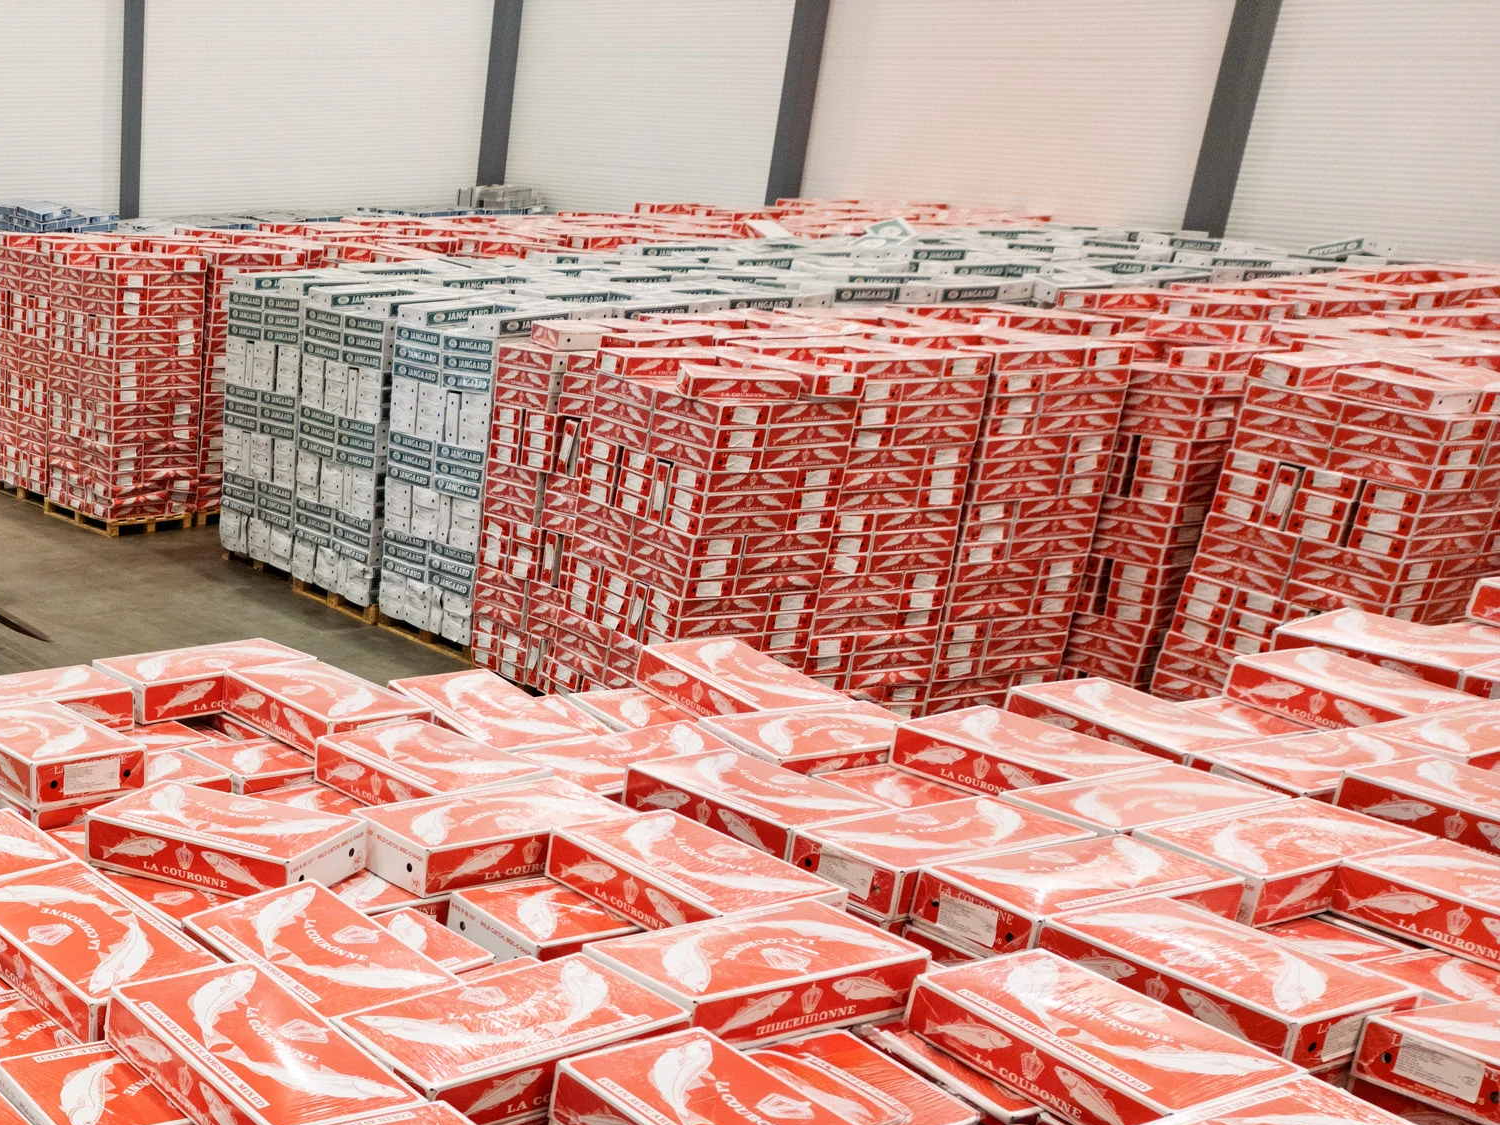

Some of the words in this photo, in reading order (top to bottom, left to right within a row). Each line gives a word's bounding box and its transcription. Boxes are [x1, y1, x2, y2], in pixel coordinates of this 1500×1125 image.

[409, 330, 438, 344] JANGAARD
[458, 341, 490, 352] JANGAARD
[458, 359, 488, 370] JANGAARD
[407, 368, 436, 382] JANGAARD
[401, 437, 430, 451] JANGAARD
[401, 454, 429, 468] JANGAARD
[449, 450, 480, 462] JANGAARD
[398, 470, 427, 486] JANGAARD
[449, 466, 479, 480] JANGAARD
[443, 481, 477, 497] JANGAARD
[143, 860, 160, 872] LA
[162, 865, 228, 889] COURONNE
[975, 1052, 994, 1072] LA
[999, 1068, 1083, 1120] COURONNE
